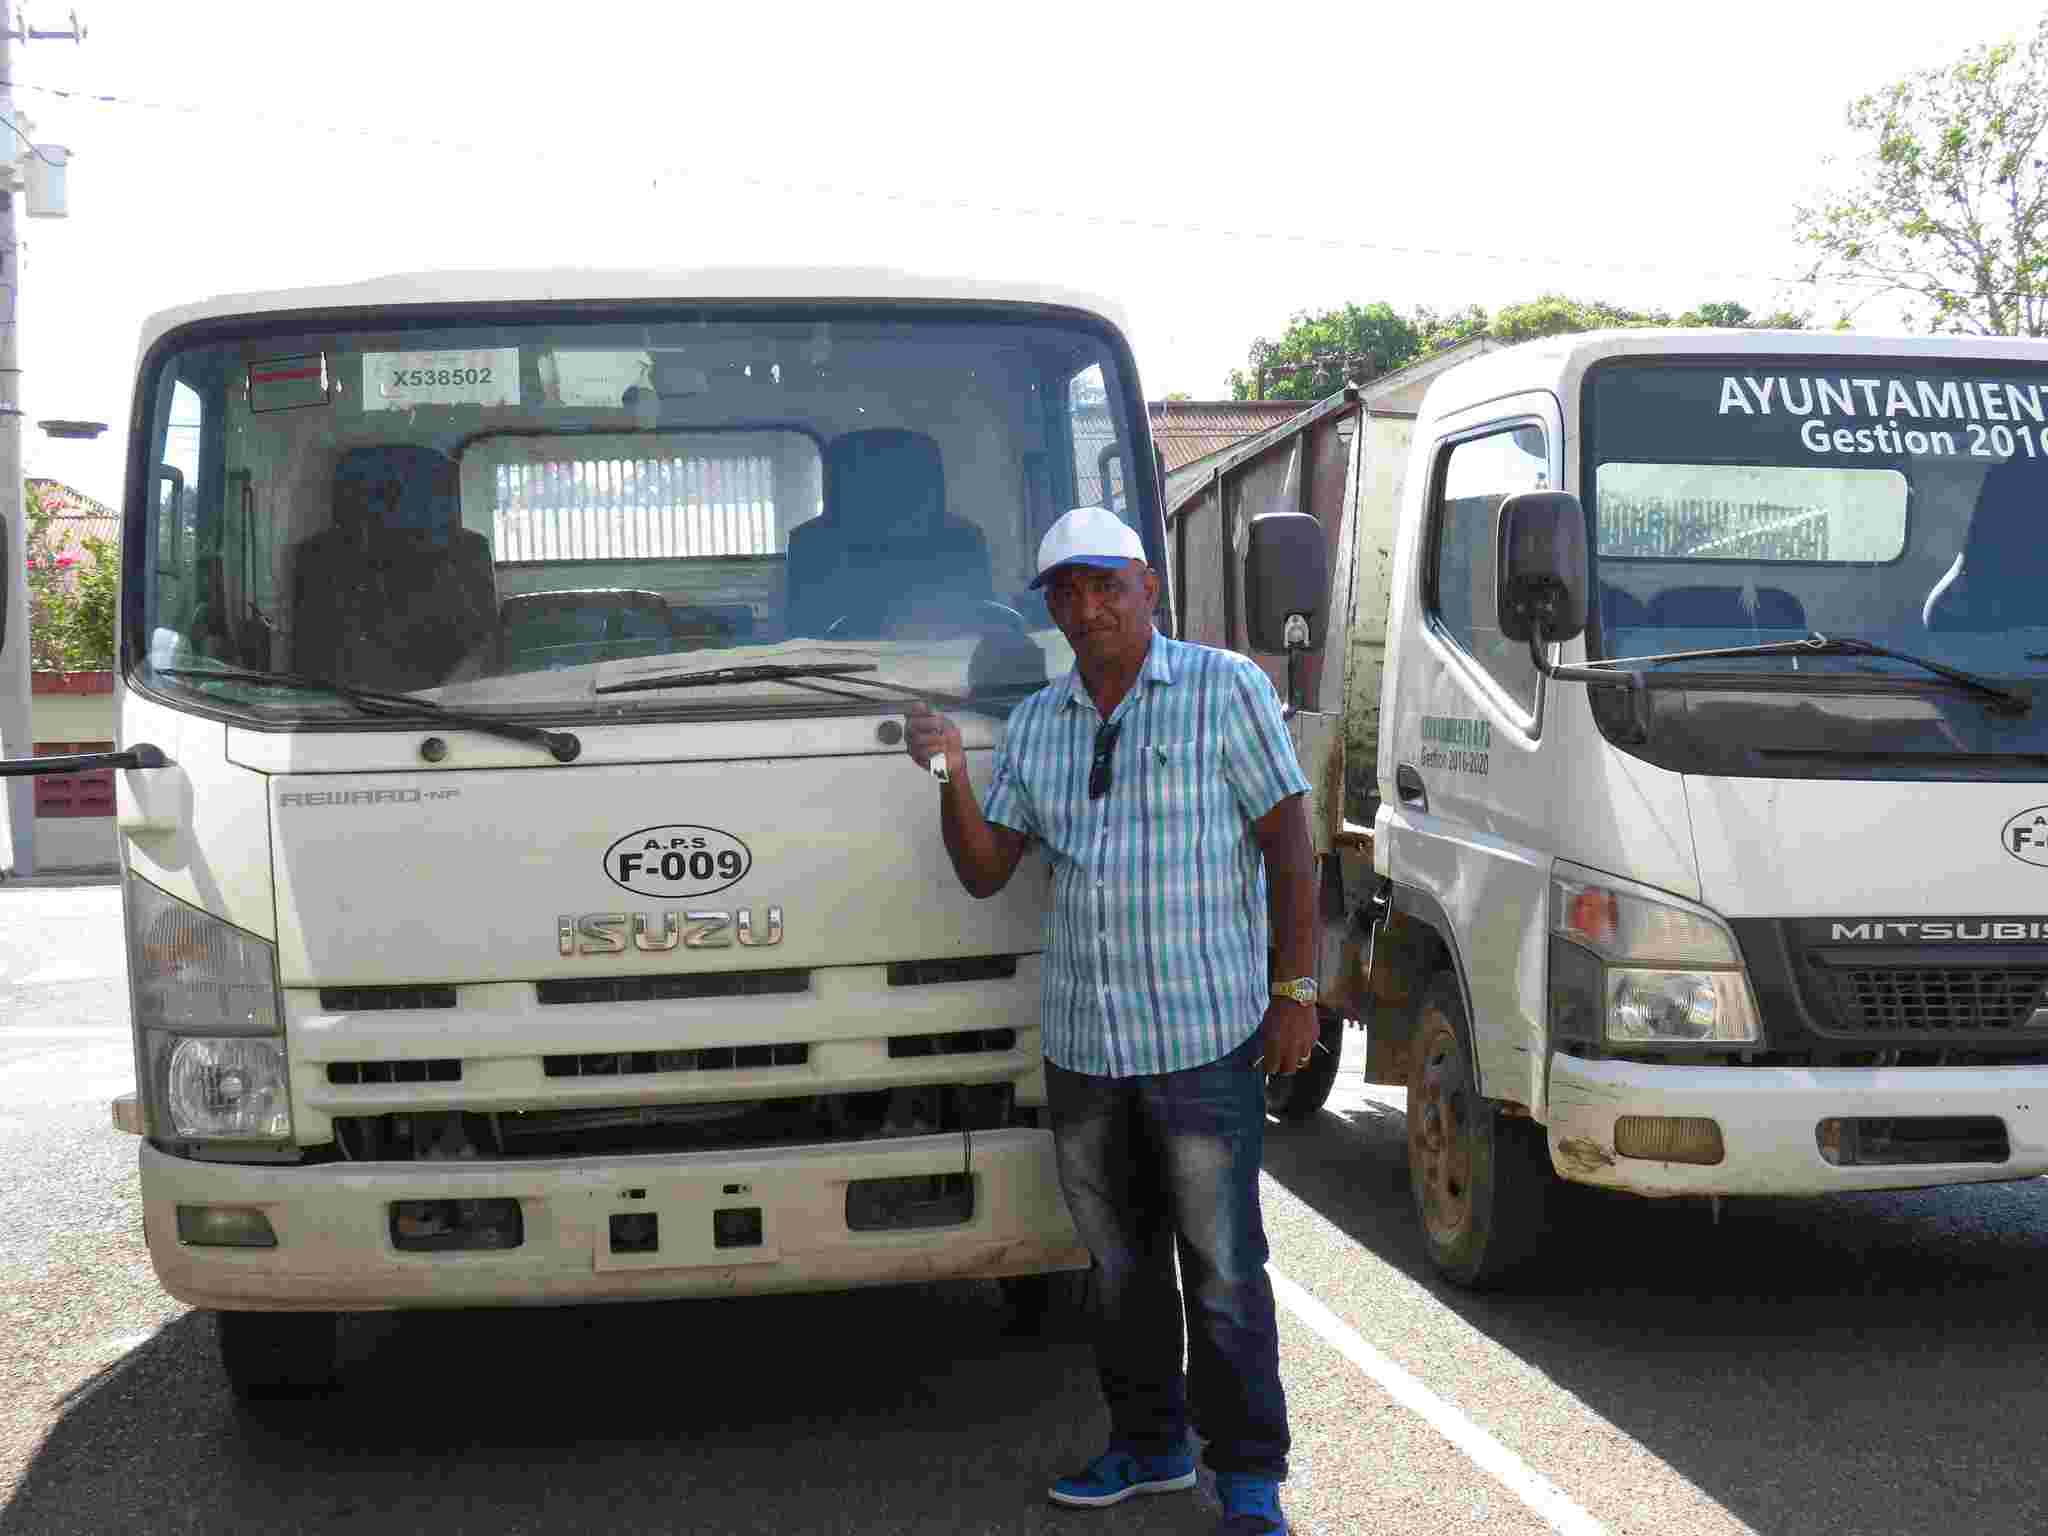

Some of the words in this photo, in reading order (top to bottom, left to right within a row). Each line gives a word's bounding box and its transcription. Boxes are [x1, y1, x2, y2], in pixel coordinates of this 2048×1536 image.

[392, 366, 494, 388] X538502
[1800, 419, 1957, 456] Gestion
[643, 837, 707, 850] A.P.S
[618, 851, 742, 882] F-009
[558, 905, 784, 956] ISUZU
[1831, 922, 2048, 941] MITSUBI
